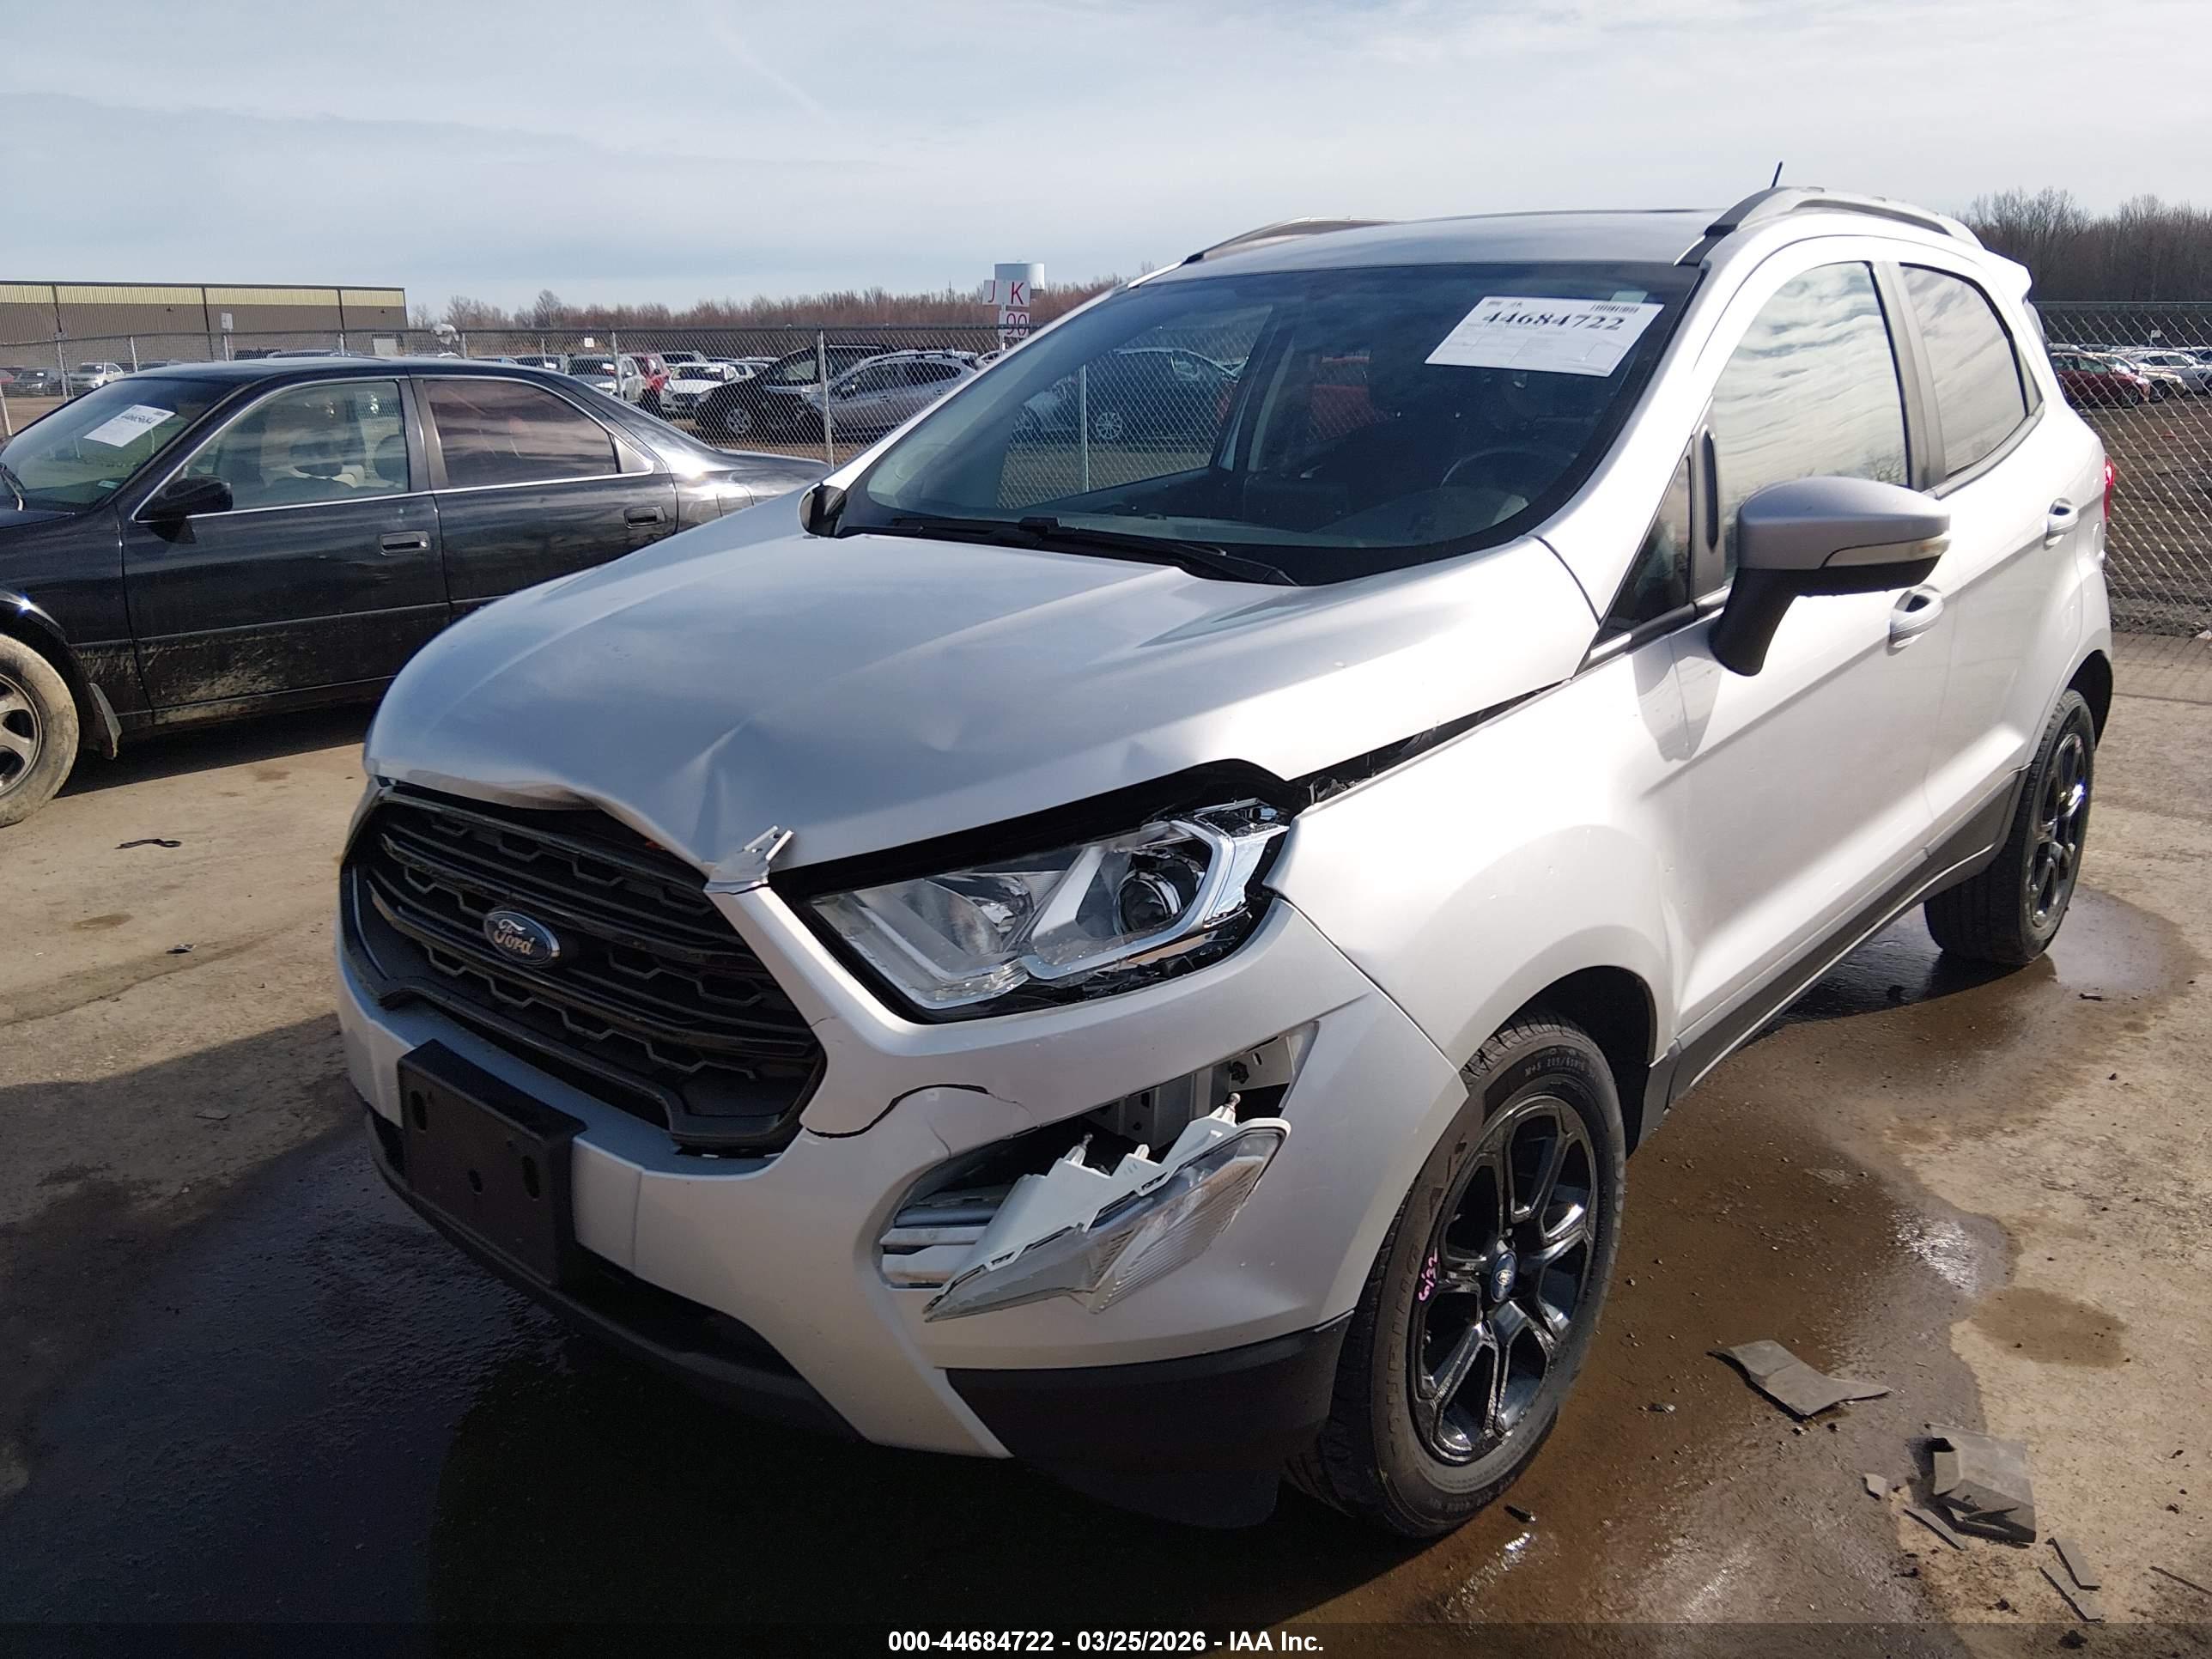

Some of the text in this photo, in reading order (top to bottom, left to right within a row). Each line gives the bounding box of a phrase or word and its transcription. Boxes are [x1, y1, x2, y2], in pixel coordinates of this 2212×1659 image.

[988, 281, 996, 303] J
[1011, 281, 1024, 305] K
[1006, 313, 1028, 336] 90
[1483, 310, 1626, 331] 44684722
[493, 918, 537, 956] Ford
